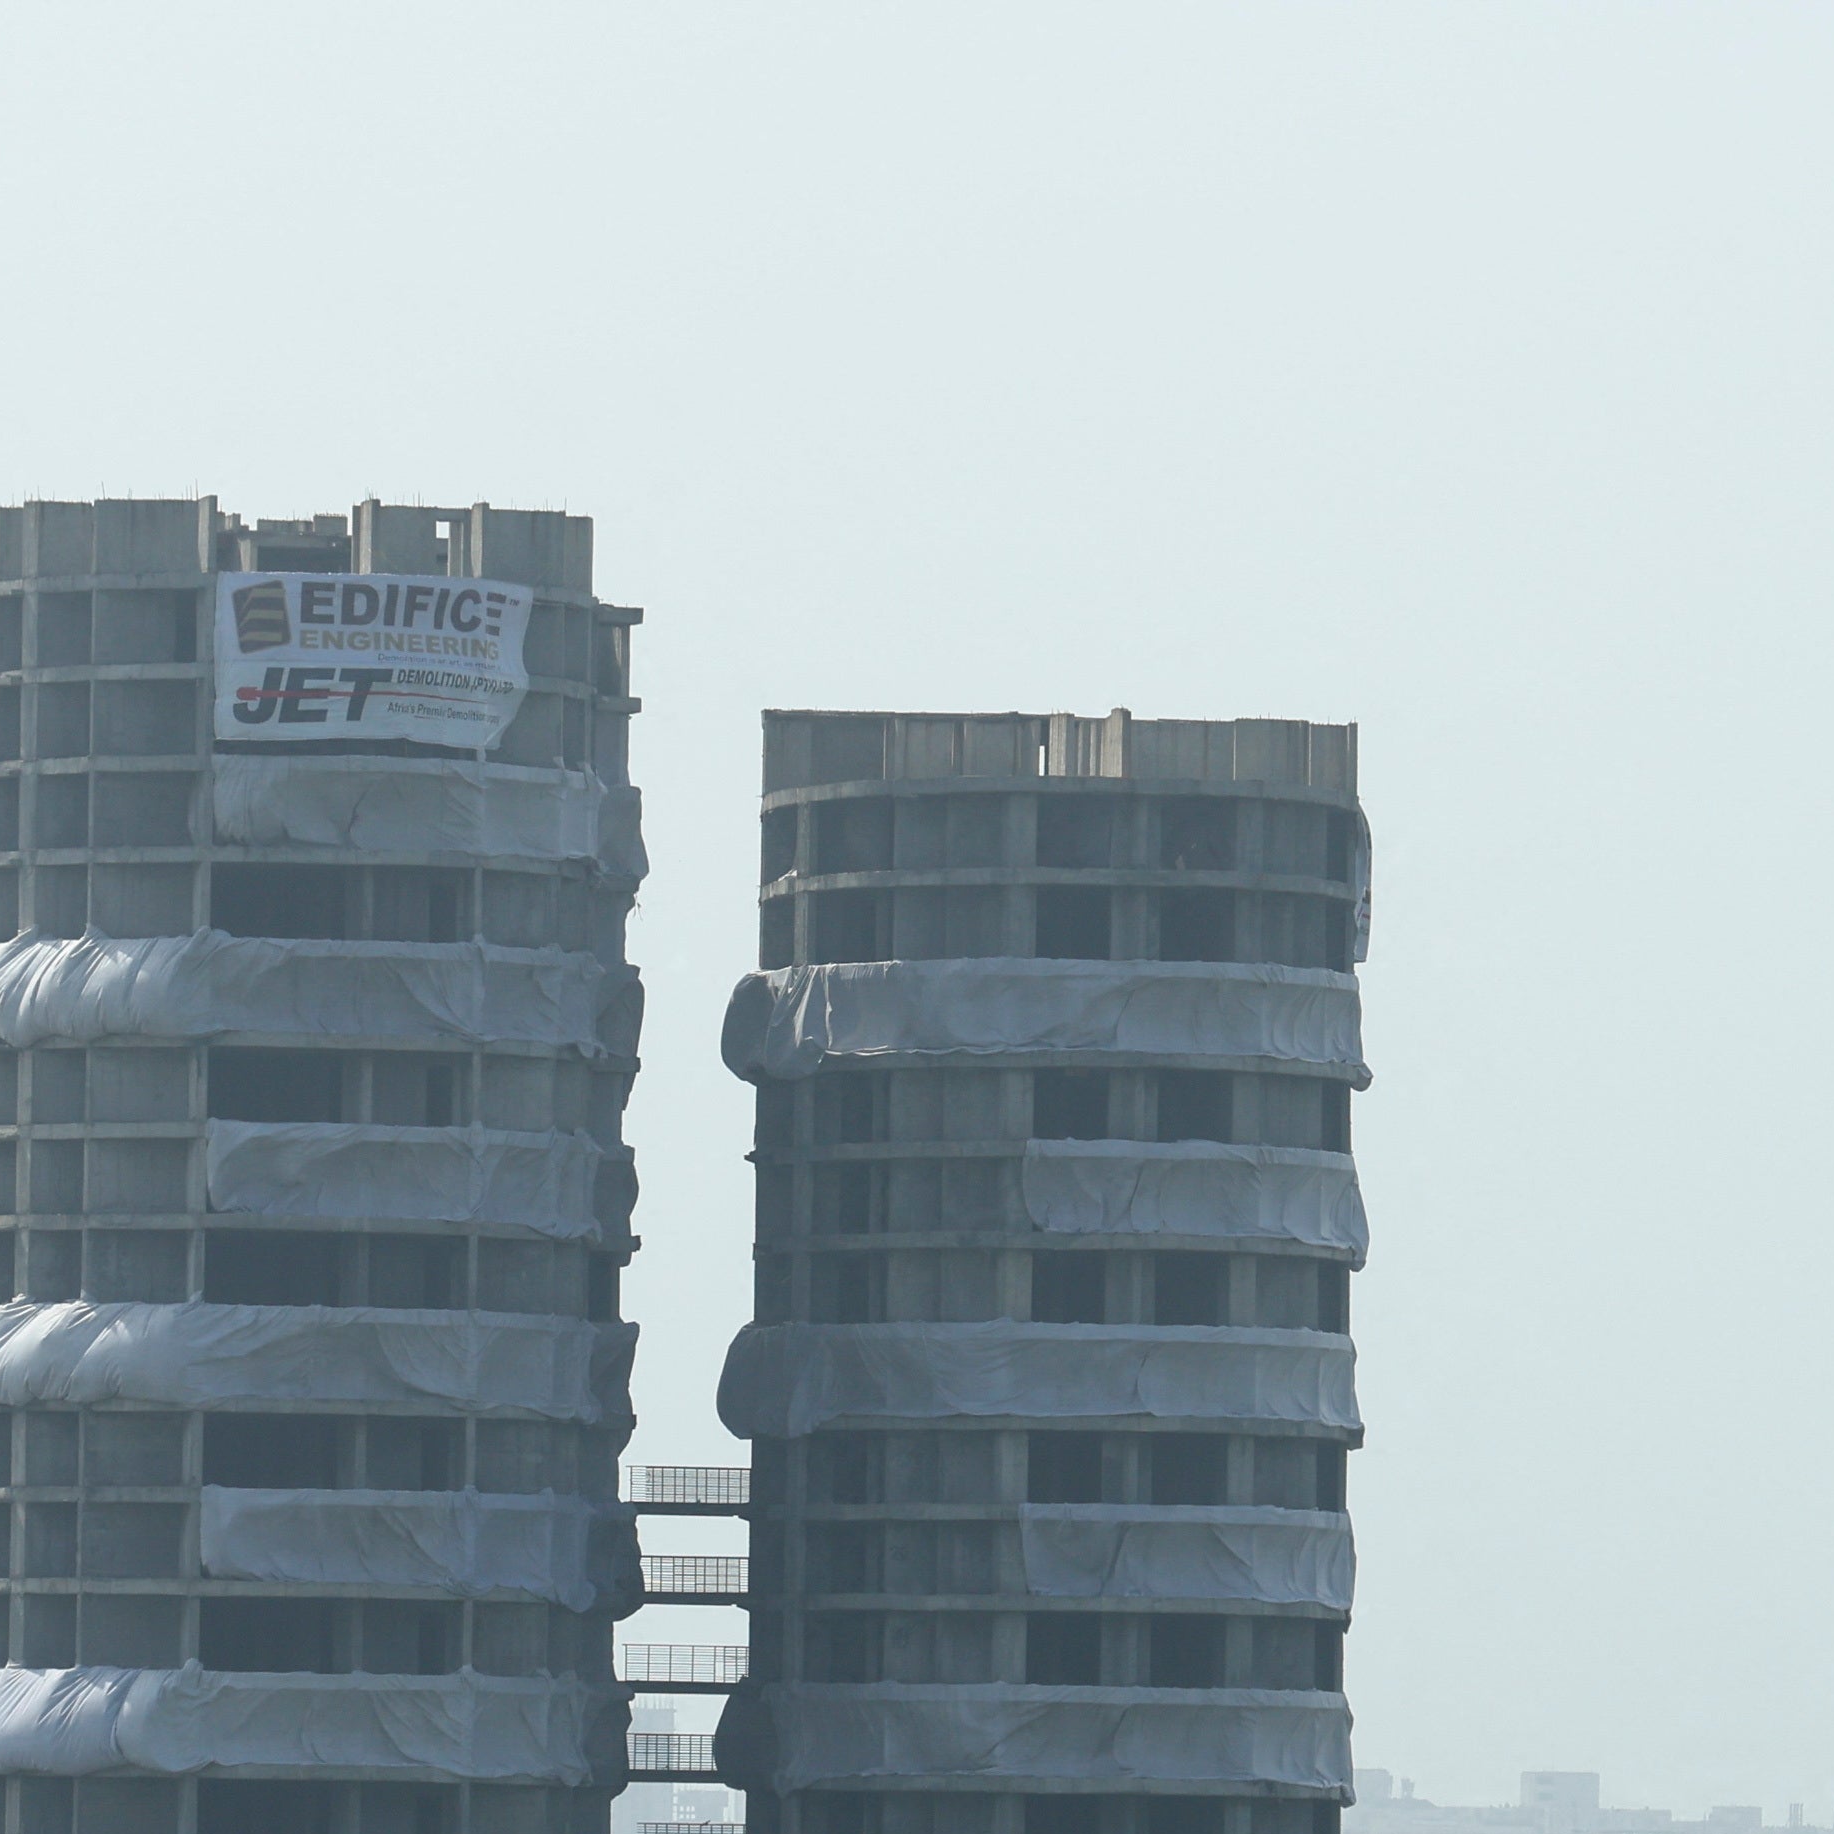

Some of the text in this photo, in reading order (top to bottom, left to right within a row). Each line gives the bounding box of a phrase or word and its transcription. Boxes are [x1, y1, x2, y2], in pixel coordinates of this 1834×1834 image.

[300, 580, 507, 637] EDIFICE
[299, 629, 499, 661] ENGINEERING
[233, 666, 394, 725] JET
[397, 669, 471, 690] DEMOLITION
